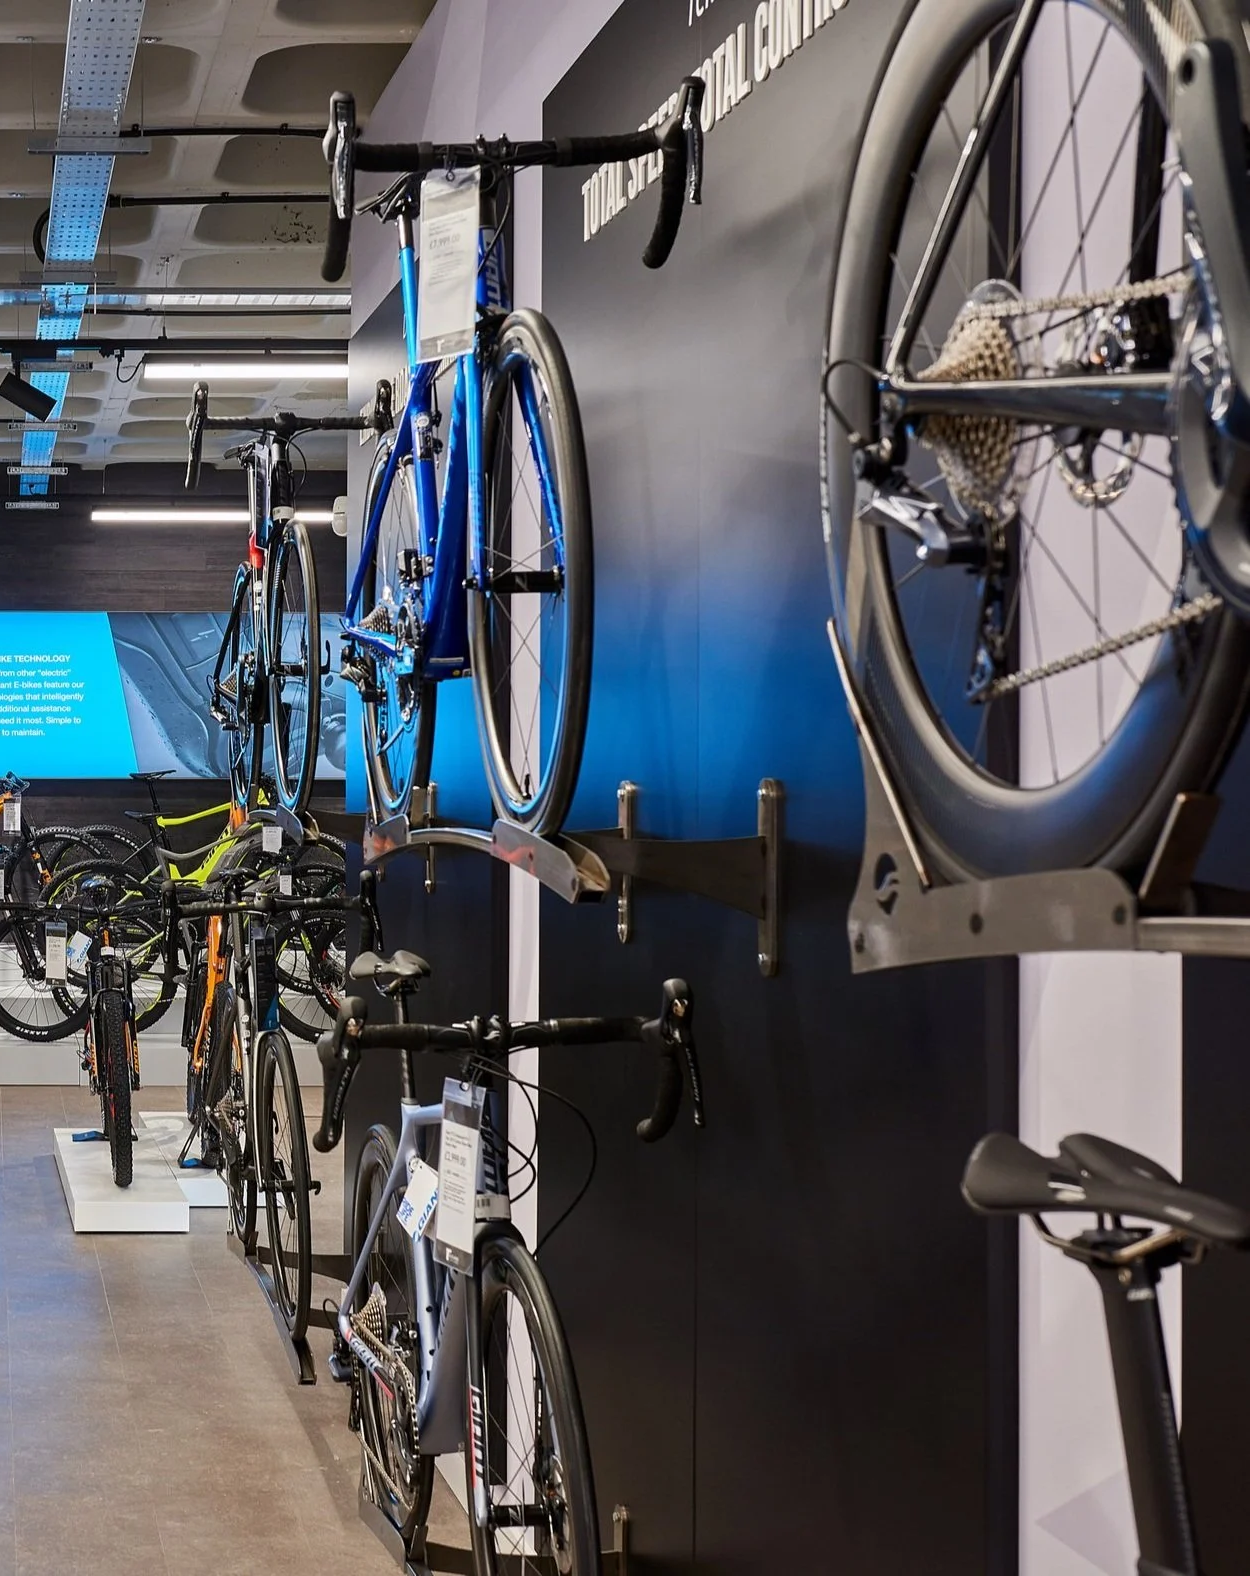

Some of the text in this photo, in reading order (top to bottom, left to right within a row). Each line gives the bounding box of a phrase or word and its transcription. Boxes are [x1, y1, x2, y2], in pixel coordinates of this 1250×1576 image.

[691, 22, 753, 133] OTAL
[14, 655, 70, 663] TECHNOLOGY
[14, 681, 42, 689] E-bikes
[44, 681, 69, 689] feature
[42, 693, 84, 702] intelligently
[16, 716, 21, 724] it
[23, 716, 44, 724] most.
[46, 716, 72, 726] Simple
[74, 716, 81, 724] to
[2, 728, 10, 736] to
[12, 728, 45, 736] maintain.
[418, 1189, 439, 1231] GIAN
